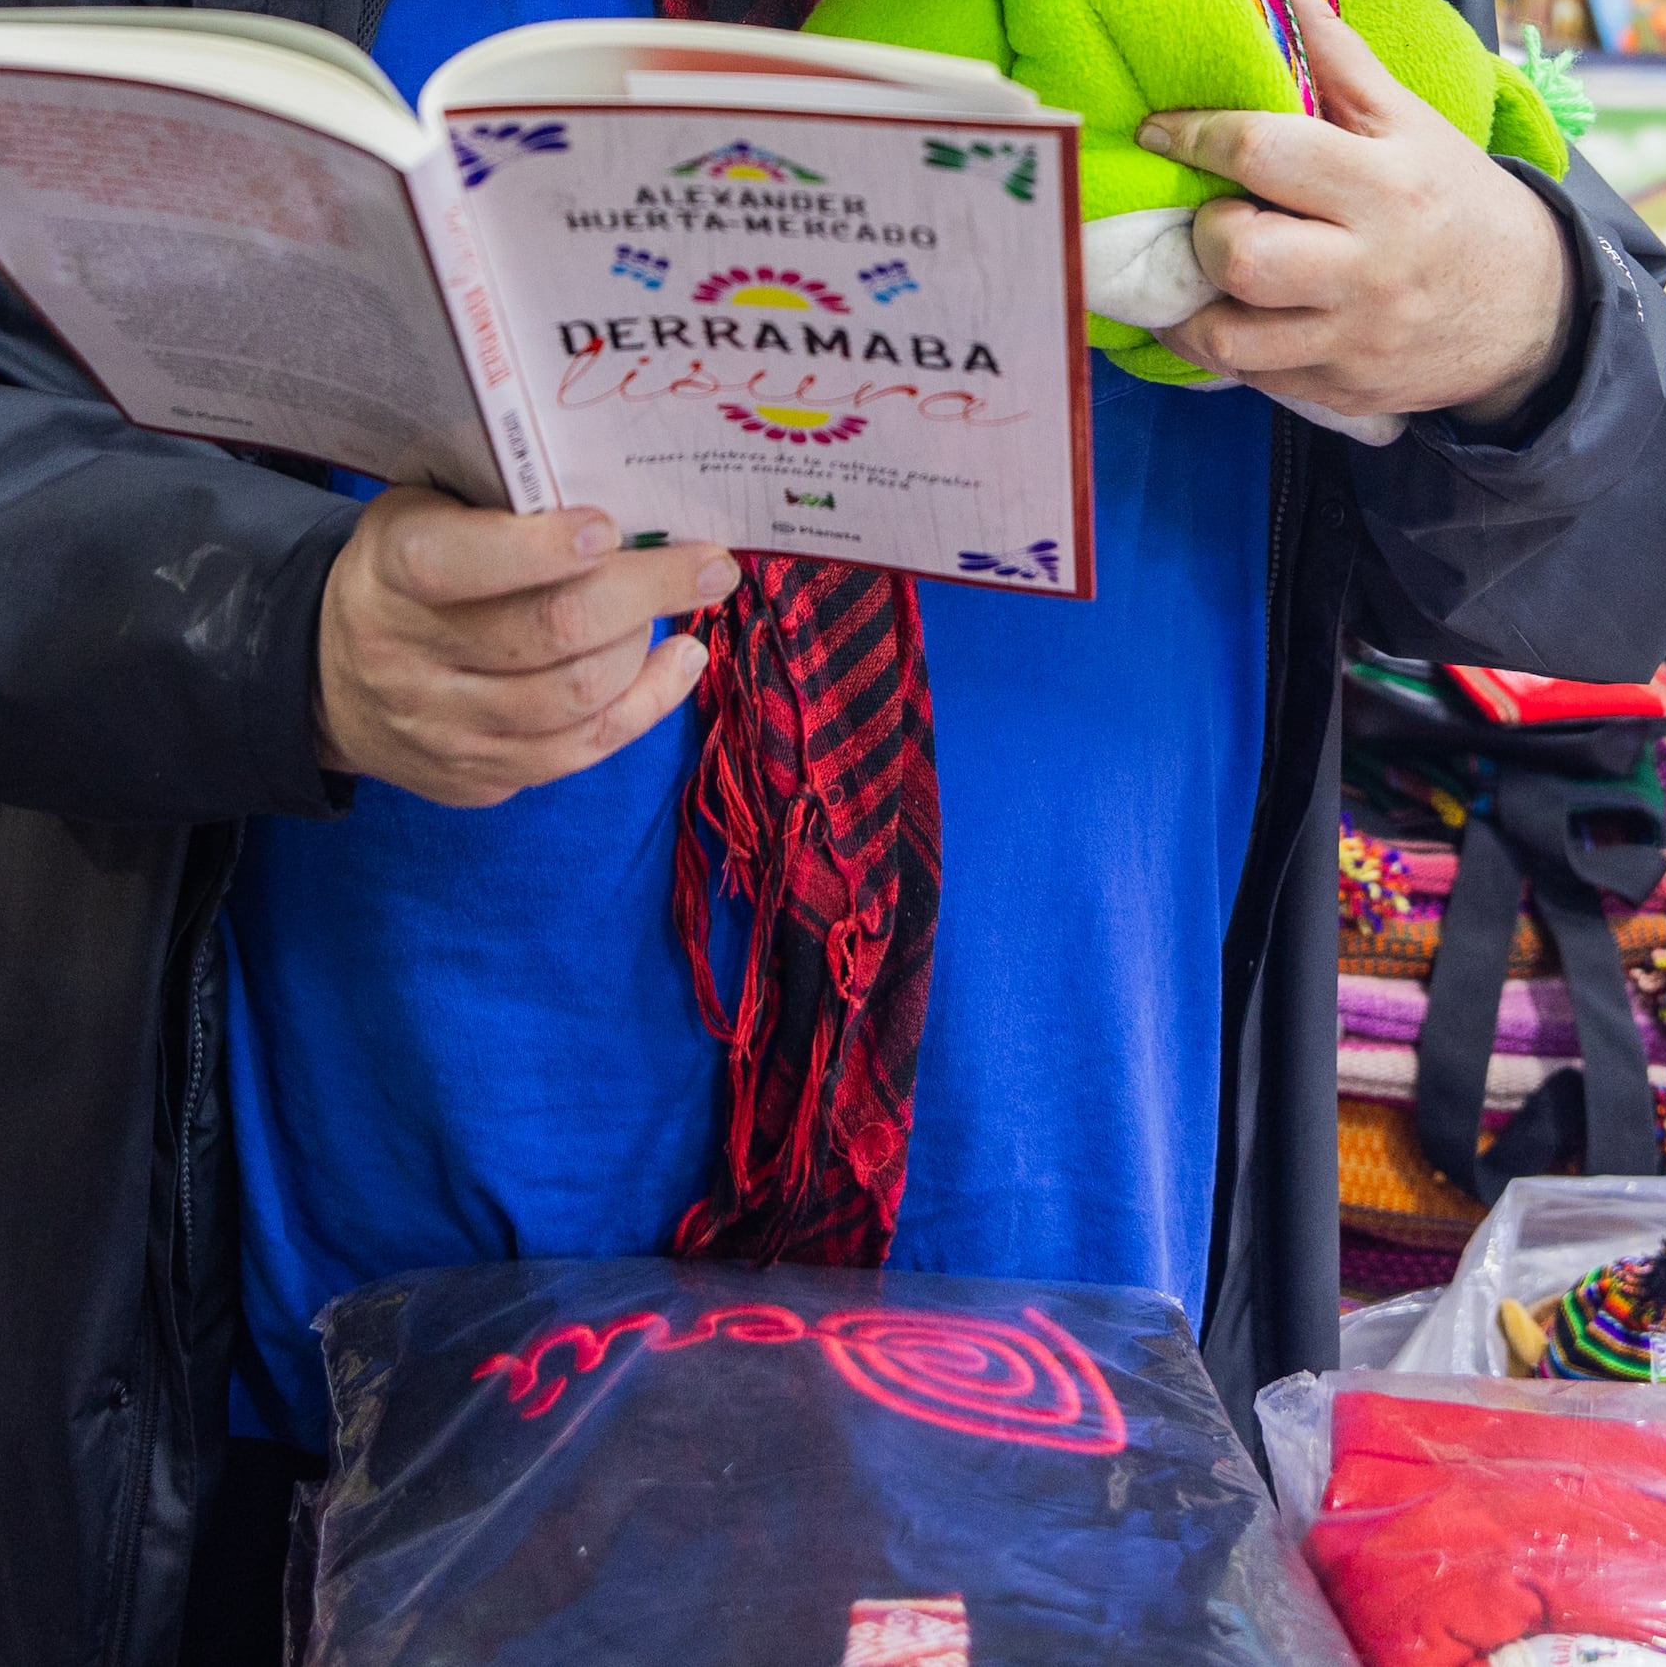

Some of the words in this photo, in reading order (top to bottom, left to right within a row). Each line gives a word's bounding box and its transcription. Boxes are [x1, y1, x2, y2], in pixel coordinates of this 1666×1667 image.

[635, 184, 869, 217] ALEXANDER
[557, 313, 1003, 377] DERRAMABA
[555, 337, 1031, 427] lisura
[907, 470, 981, 489] popular
